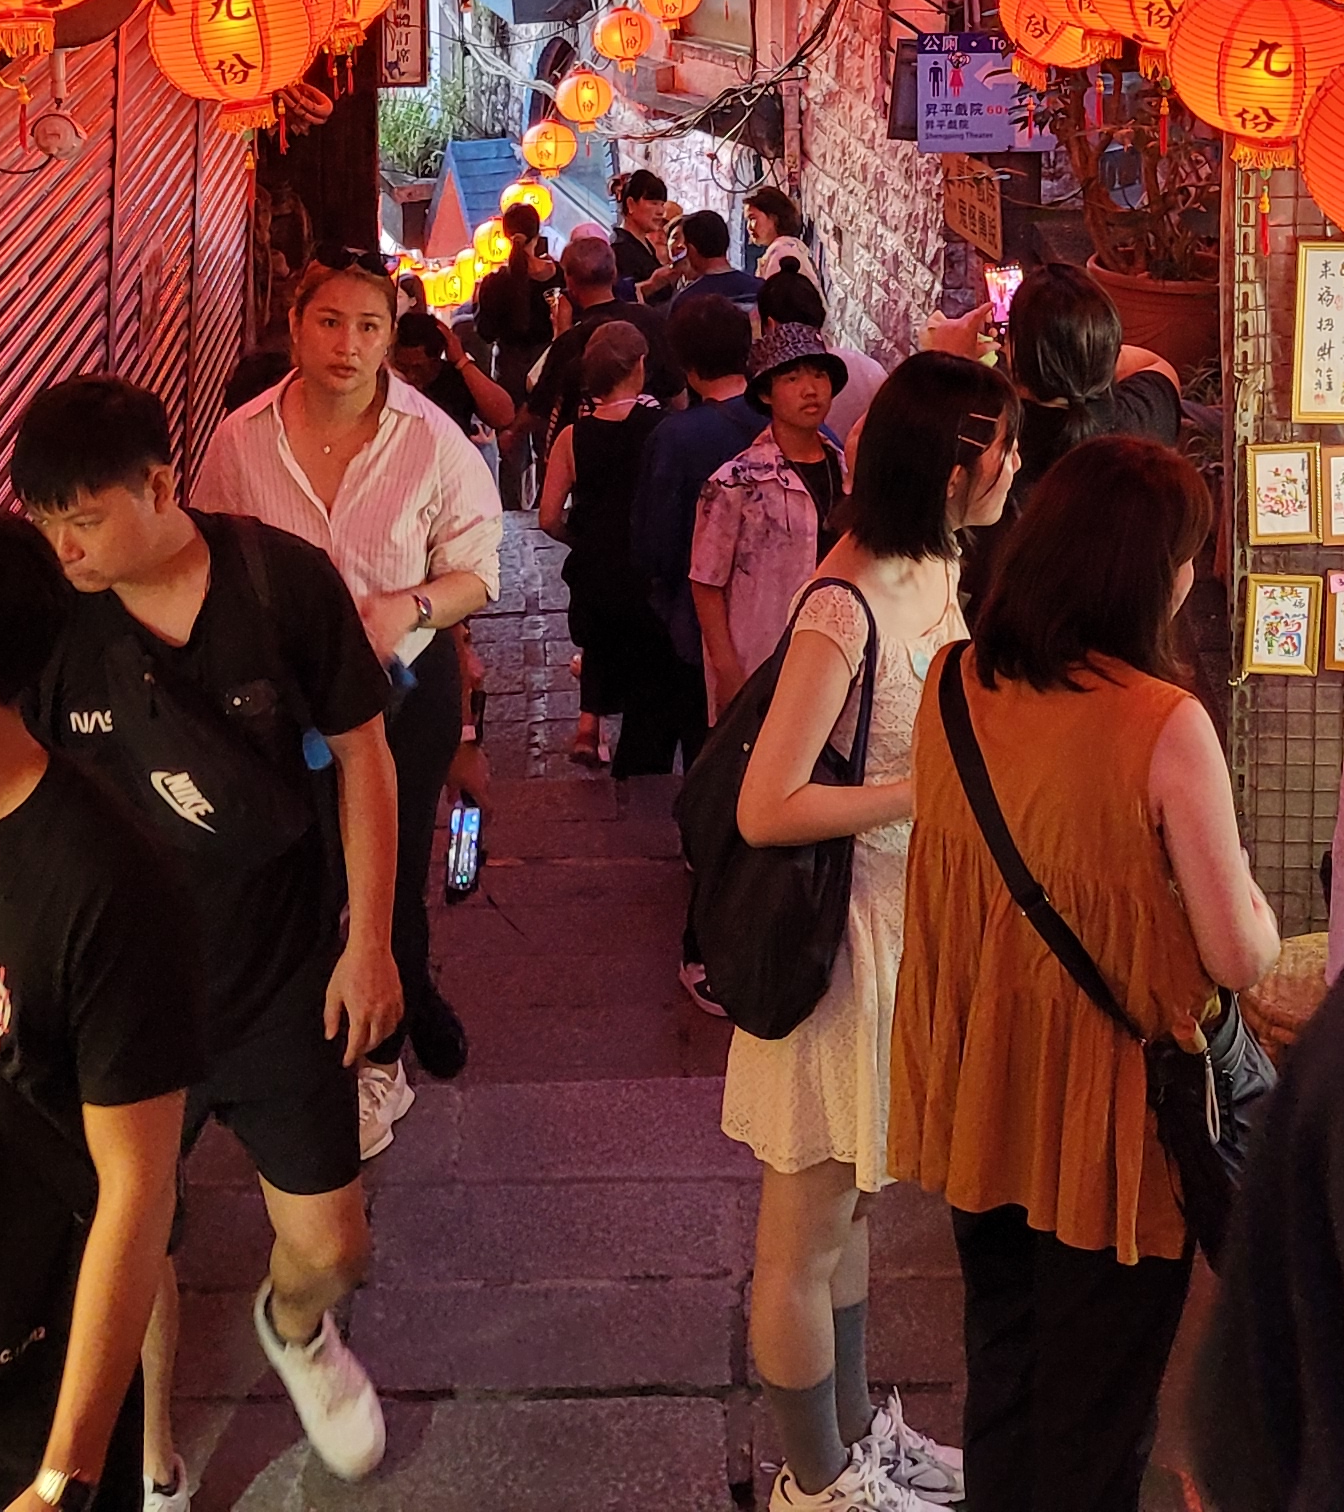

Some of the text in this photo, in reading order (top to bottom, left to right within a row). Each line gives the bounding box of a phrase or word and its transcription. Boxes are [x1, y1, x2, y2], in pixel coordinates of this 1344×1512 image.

[624, 16, 639, 50] 九份
[580, 80, 595, 114] 九份
[1234, 39, 1293, 134] 九份
